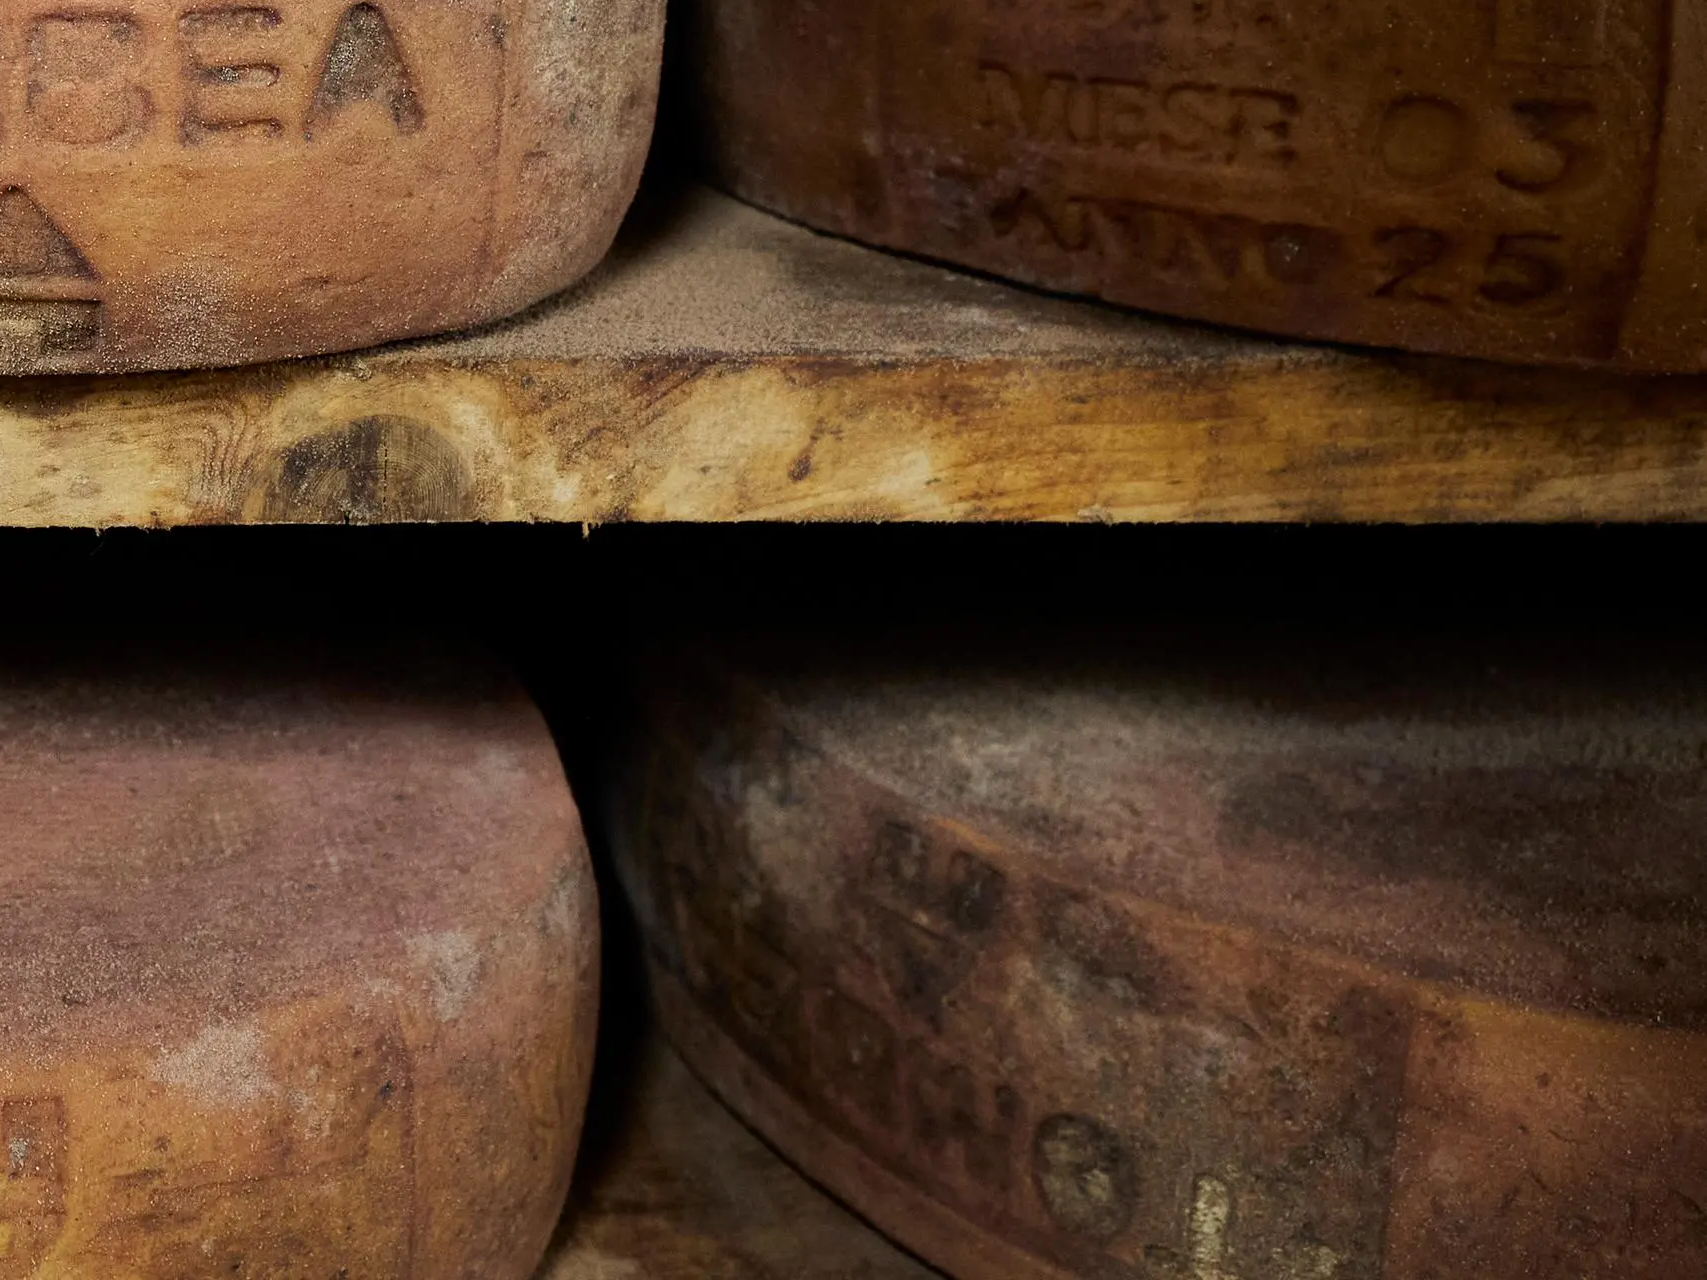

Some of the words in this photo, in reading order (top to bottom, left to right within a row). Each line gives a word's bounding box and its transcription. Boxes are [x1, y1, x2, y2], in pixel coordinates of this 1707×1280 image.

[975, 56, 1303, 165] MESE
[1373, 90, 1602, 194] 03
[1368, 223, 1568, 308] 25
